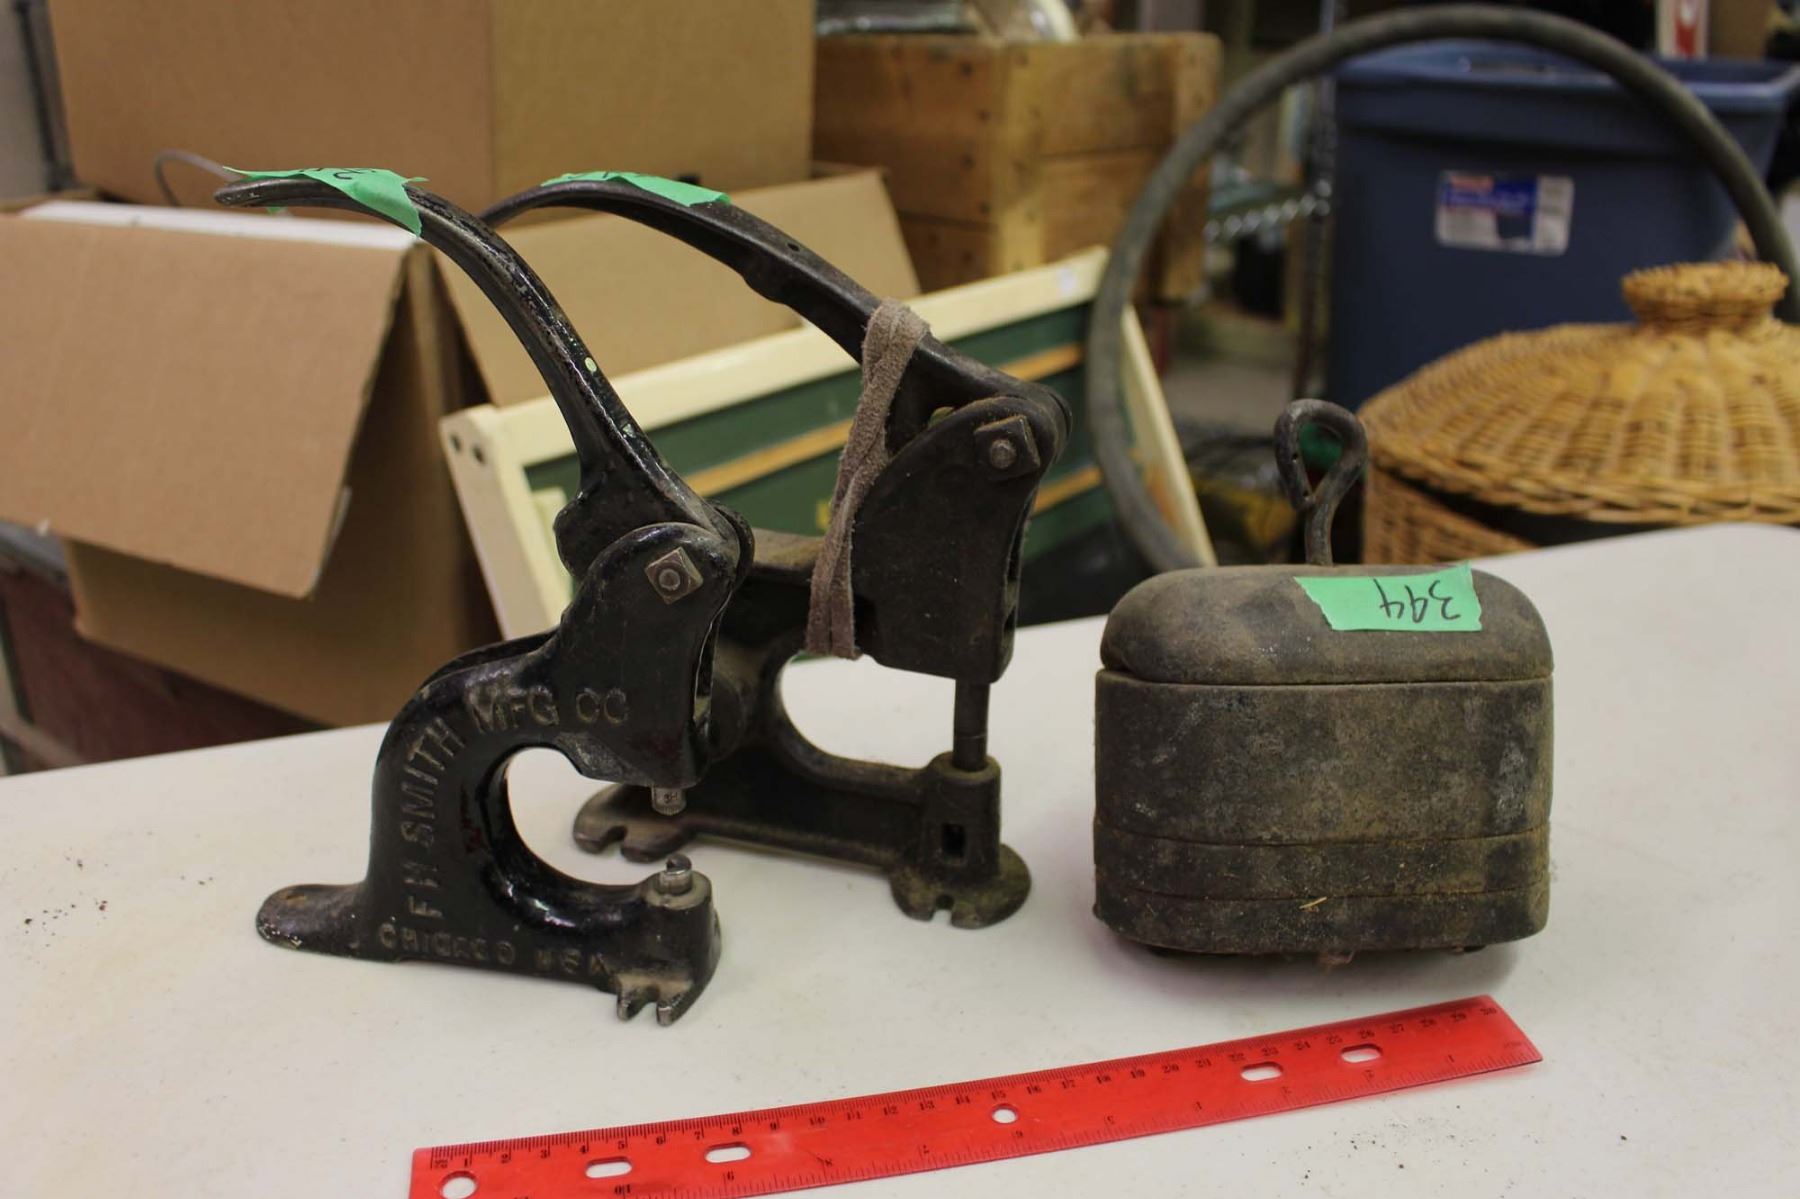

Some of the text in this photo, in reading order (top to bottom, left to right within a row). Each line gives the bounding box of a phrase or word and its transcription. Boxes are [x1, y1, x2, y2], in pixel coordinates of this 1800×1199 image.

[1373, 577, 1462, 624] 394
[400, 717, 467, 848] SMITH
[466, 683, 561, 735] MFG
[575, 686, 630, 725] CO
